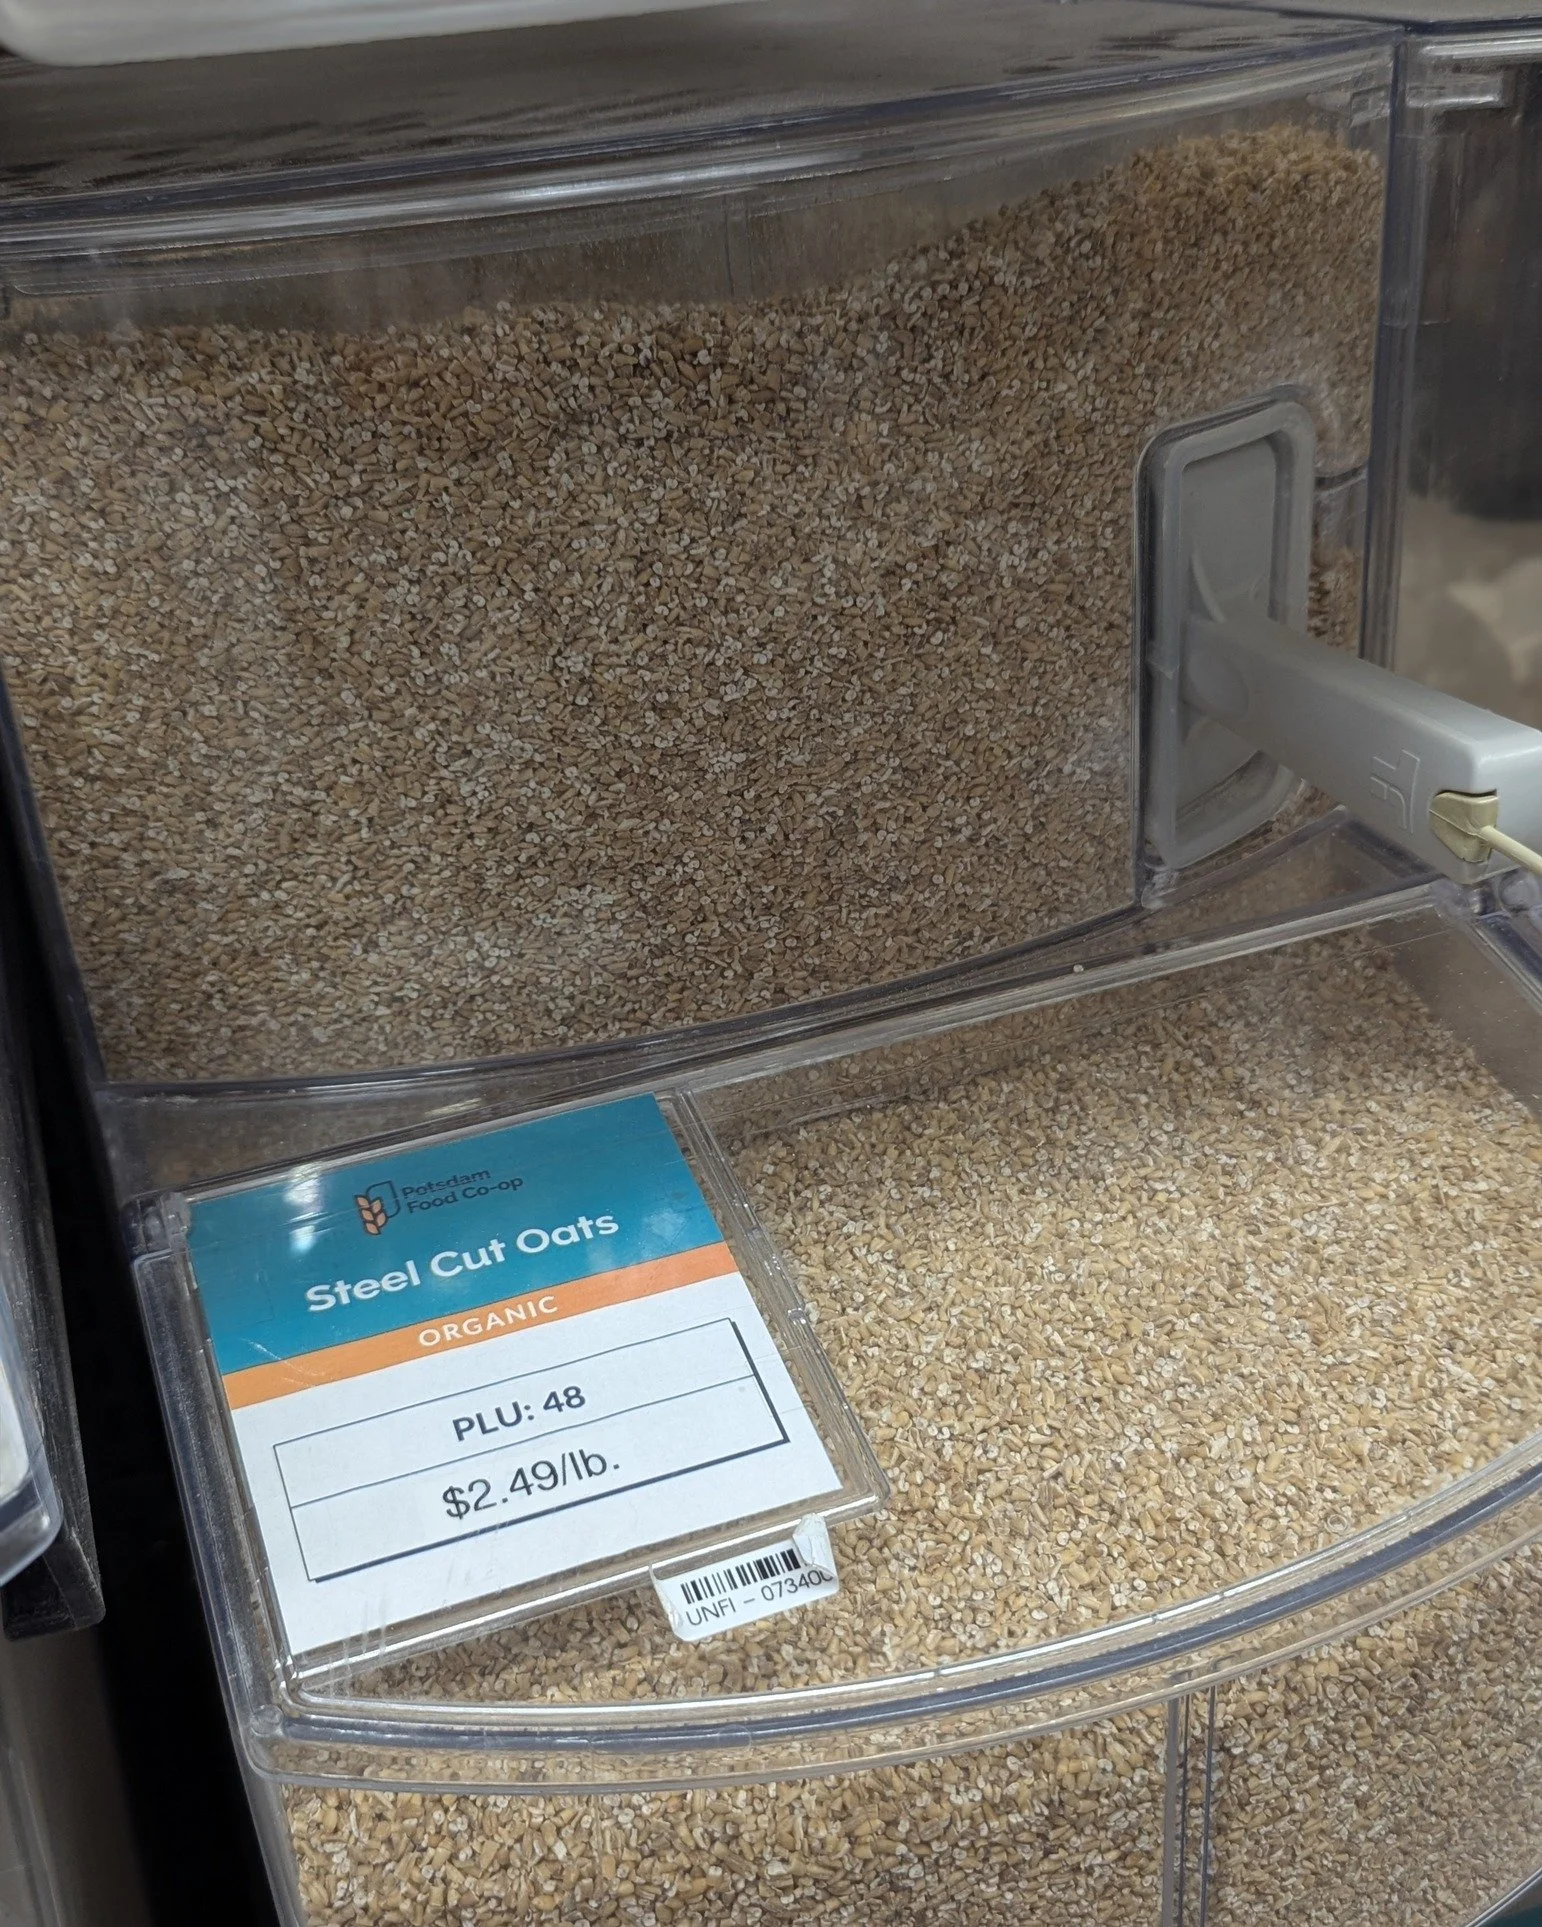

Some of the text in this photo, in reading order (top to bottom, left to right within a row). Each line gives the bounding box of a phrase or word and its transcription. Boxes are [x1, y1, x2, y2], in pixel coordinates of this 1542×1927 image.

[402, 1170, 491, 1199] Potsdam
[407, 1176, 524, 1214] Food Co-op
[306, 1214, 619, 1312] Steel Cut Oats
[418, 1295, 559, 1348] ORGANIC
[452, 1385, 586, 1442] PLU: 48
[442, 1449, 620, 1520] $2.49/lb.
[686, 1598, 737, 1626] UNFI
